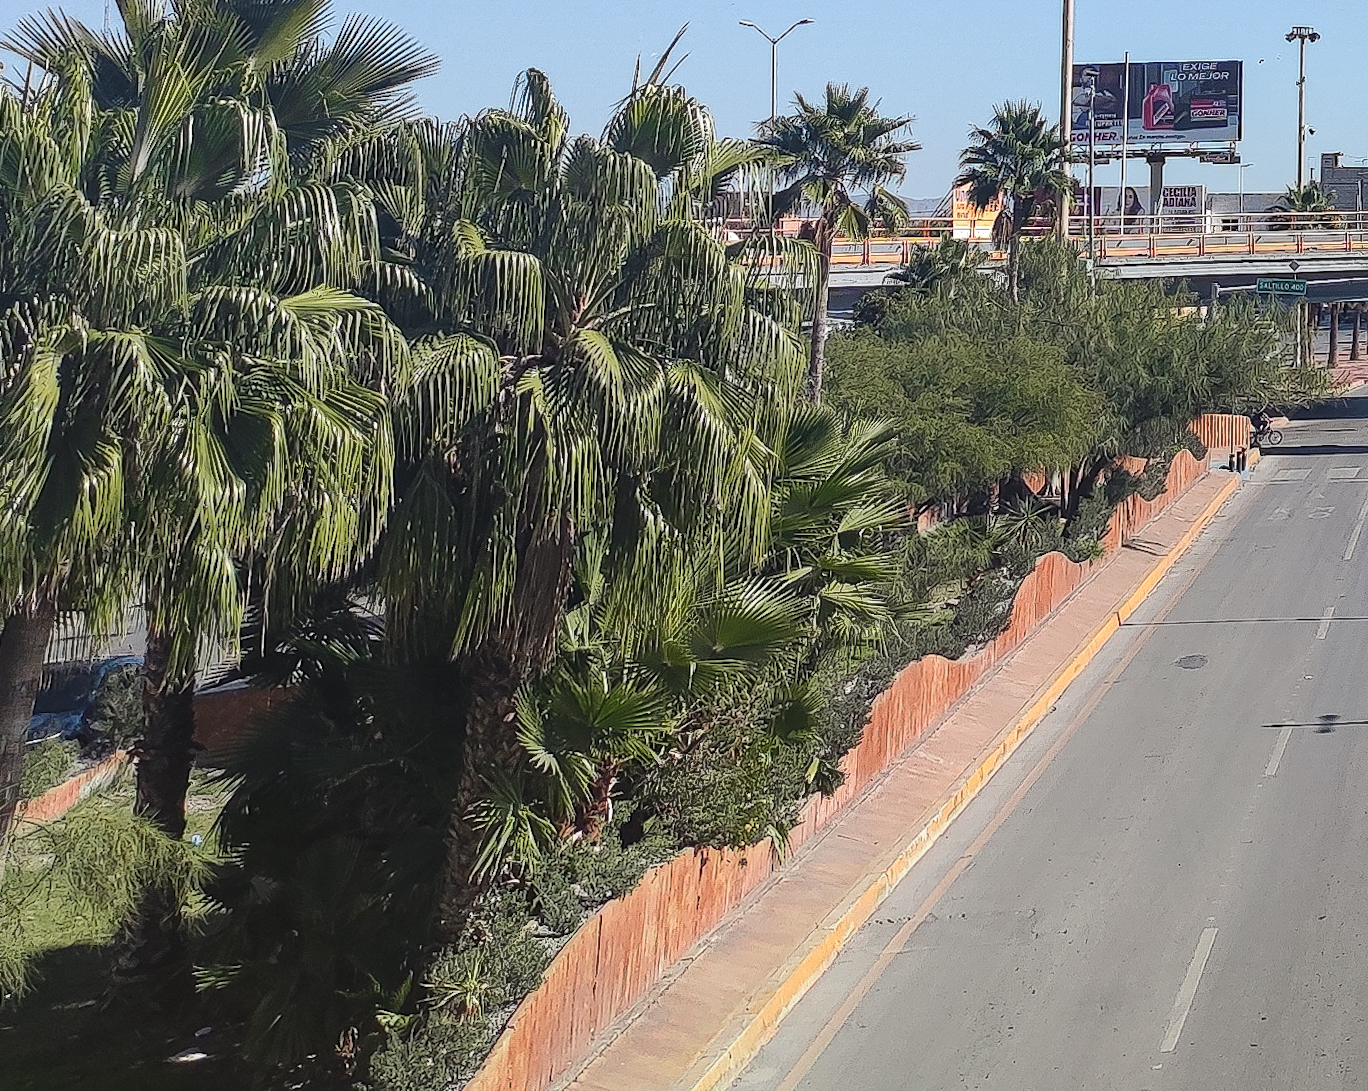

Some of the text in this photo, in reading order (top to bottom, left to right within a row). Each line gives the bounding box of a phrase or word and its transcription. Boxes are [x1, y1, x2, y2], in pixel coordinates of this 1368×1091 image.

[1182, 62, 1218, 71] EXIGE
[1170, 71, 1230, 81] LO MEJOR
[1259, 282, 1290, 290] SALTILLO
